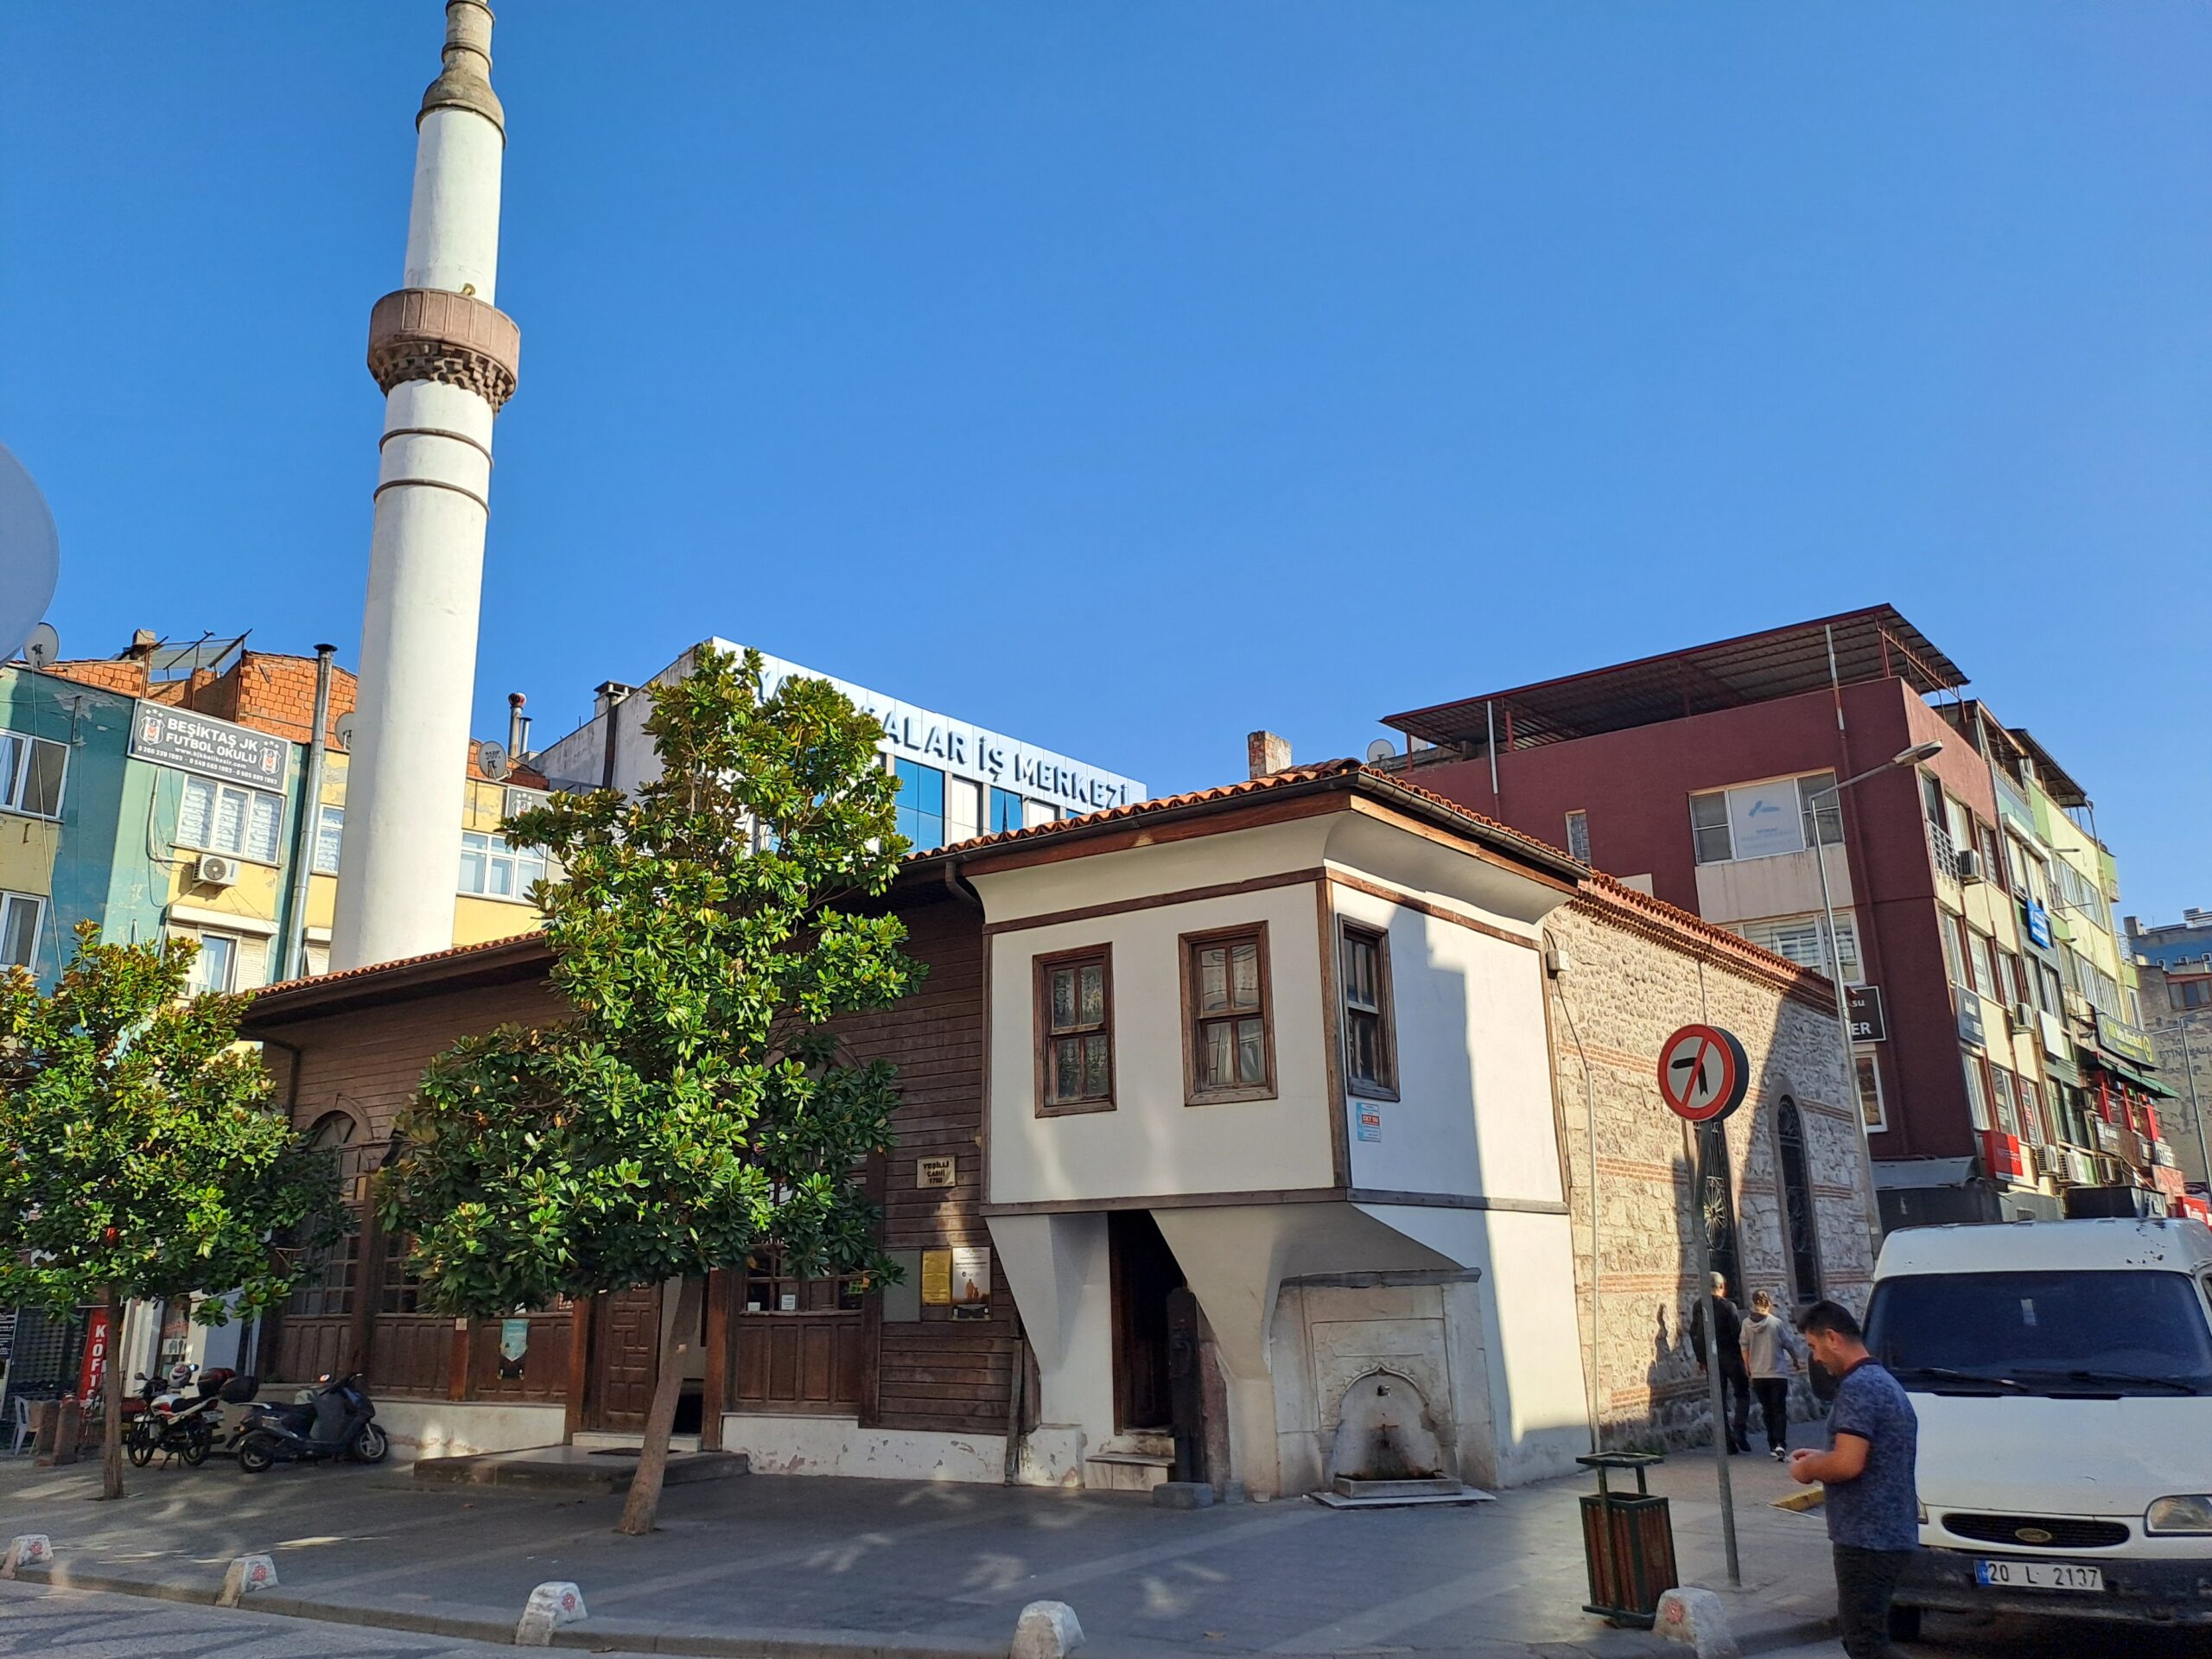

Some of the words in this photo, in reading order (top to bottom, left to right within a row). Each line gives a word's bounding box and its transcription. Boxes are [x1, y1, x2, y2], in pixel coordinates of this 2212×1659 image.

[168, 718, 237, 749] BEŞİKTAŞ
[239, 739, 258, 753] JK
[156, 749, 168, 758] 239
[166, 733, 214, 753] FUTBOL
[217, 746, 257, 764] OKULU
[979, 735, 1008, 782] İŞ
[1014, 753, 1128, 810] MERKEZİ
[923, 1160, 950, 1170] YEŞİLLİ
[926, 1168, 945, 1178] CAMİİ
[1988, 1563, 2009, 1582] 20
[2025, 1566, 2038, 1584] L
[2053, 1567, 2098, 1587] 2137
